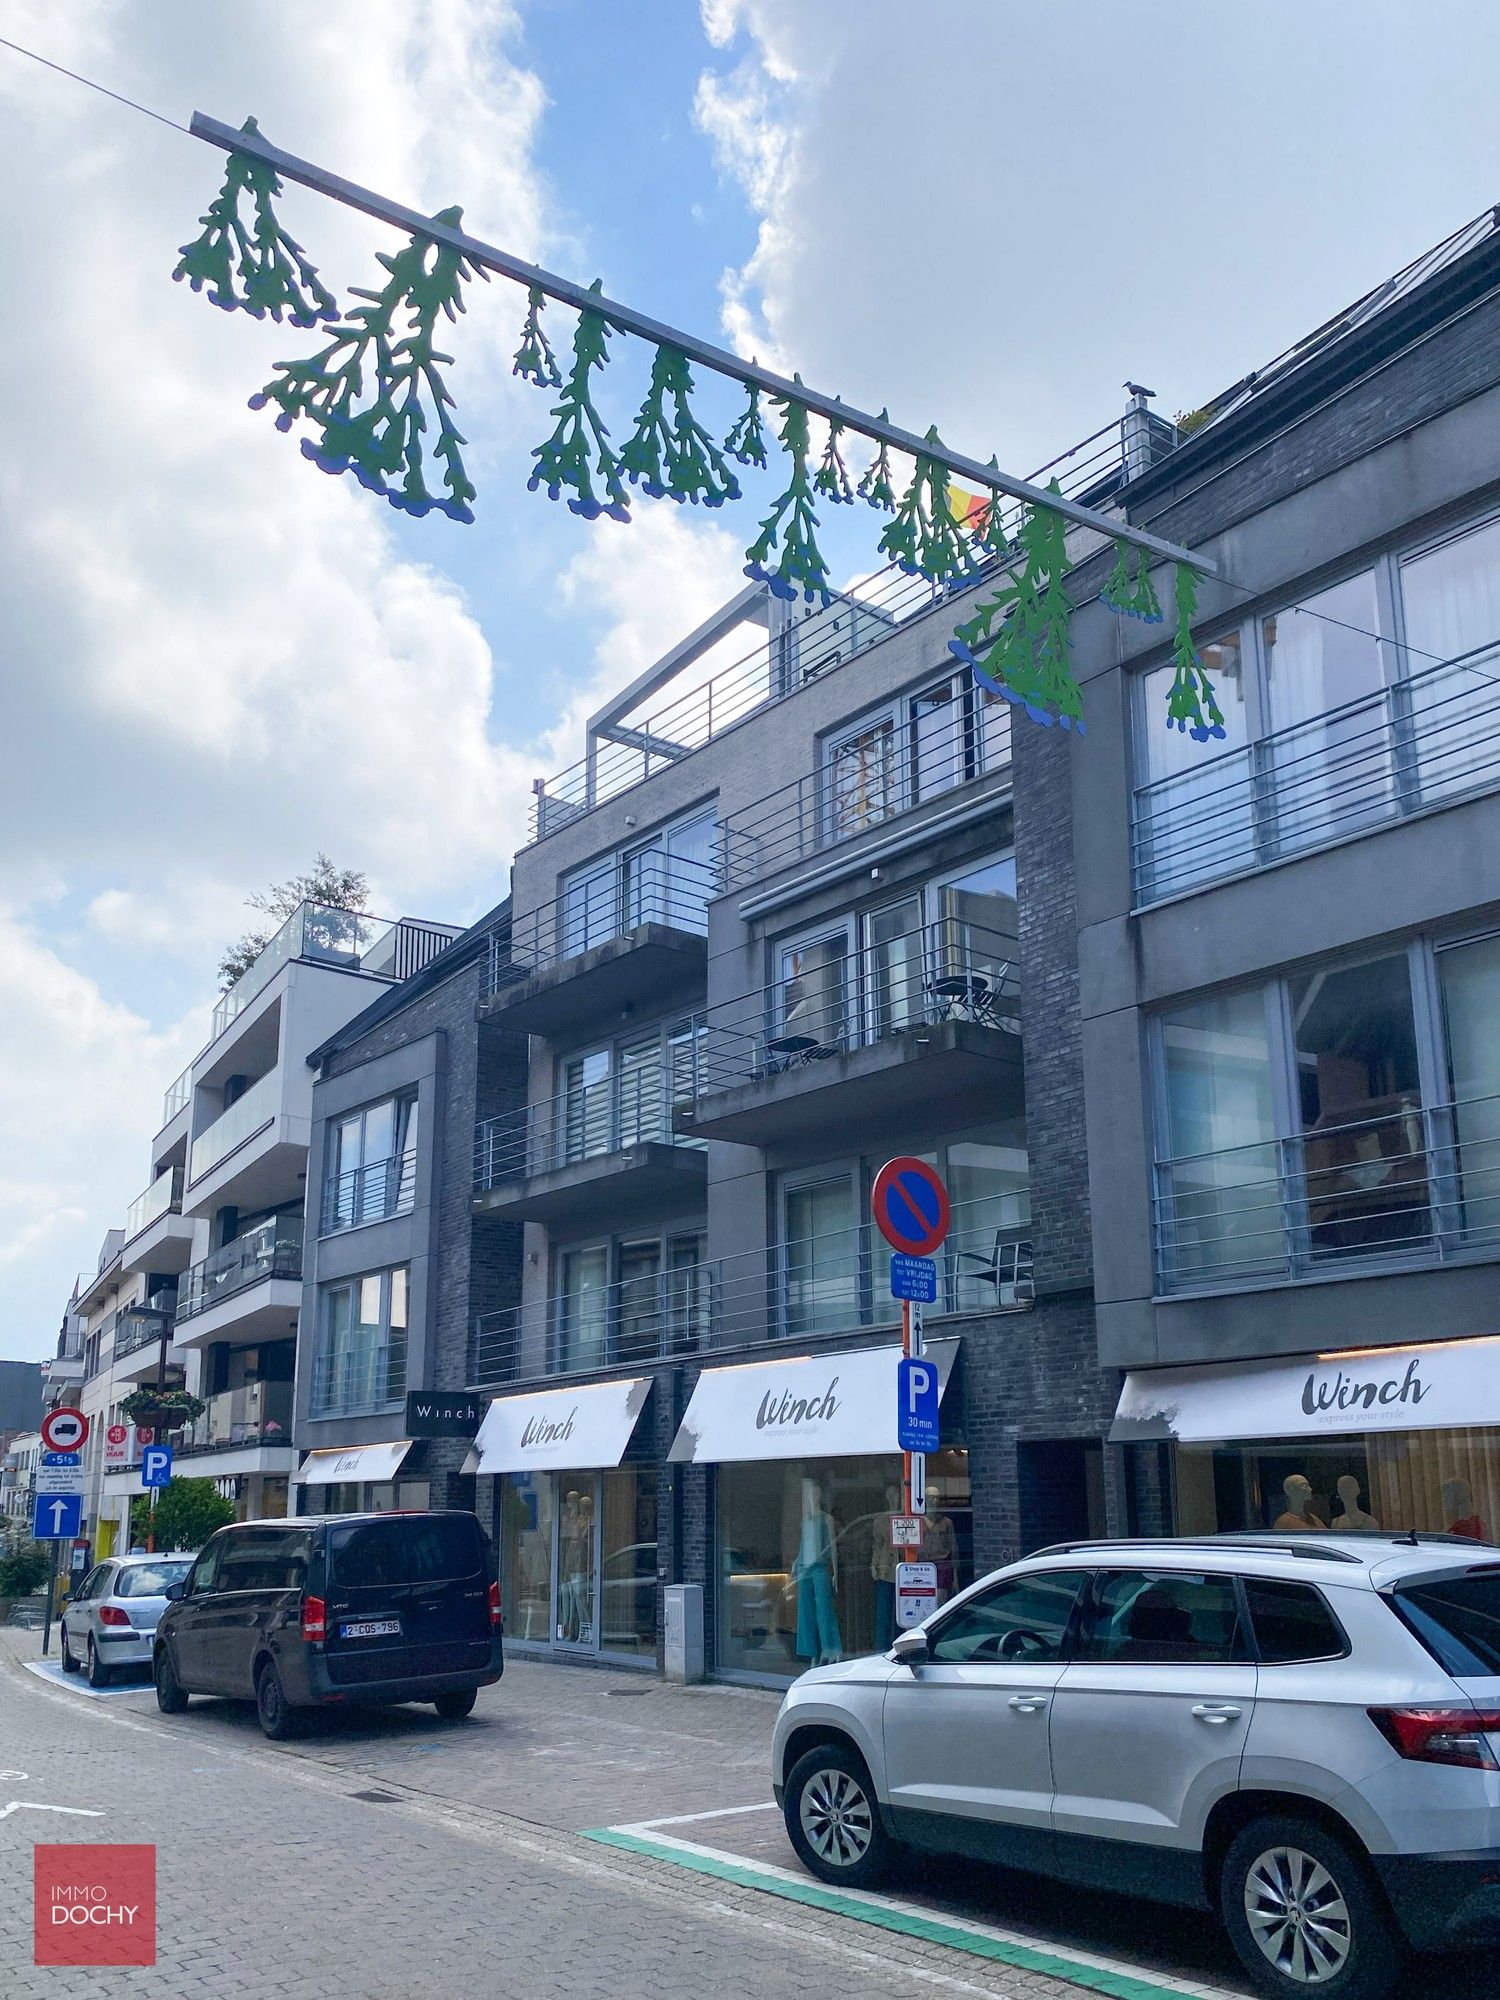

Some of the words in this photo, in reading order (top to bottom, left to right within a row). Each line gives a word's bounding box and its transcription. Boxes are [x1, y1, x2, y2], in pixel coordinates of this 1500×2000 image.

[904, 1259, 935, 1271] MAANDAG
[906, 1269, 933, 1280] VRIJDAG
[909, 1366, 930, 1413] P
[1301, 1359, 1432, 1415] Winch
[416, 1405, 475, 1419] Winch
[756, 1376, 843, 1429] Winch
[521, 1406, 578, 1448] Winch
[908, 1417, 918, 1427] 30
[919, 1420, 933, 1429] min
[1319, 1414, 1354, 1424] express
[1354, 1413, 1377, 1424] your
[1381, 1409, 1404, 1421] style
[146, 1452, 168, 1480] P
[333, 1451, 363, 1474] Winch
